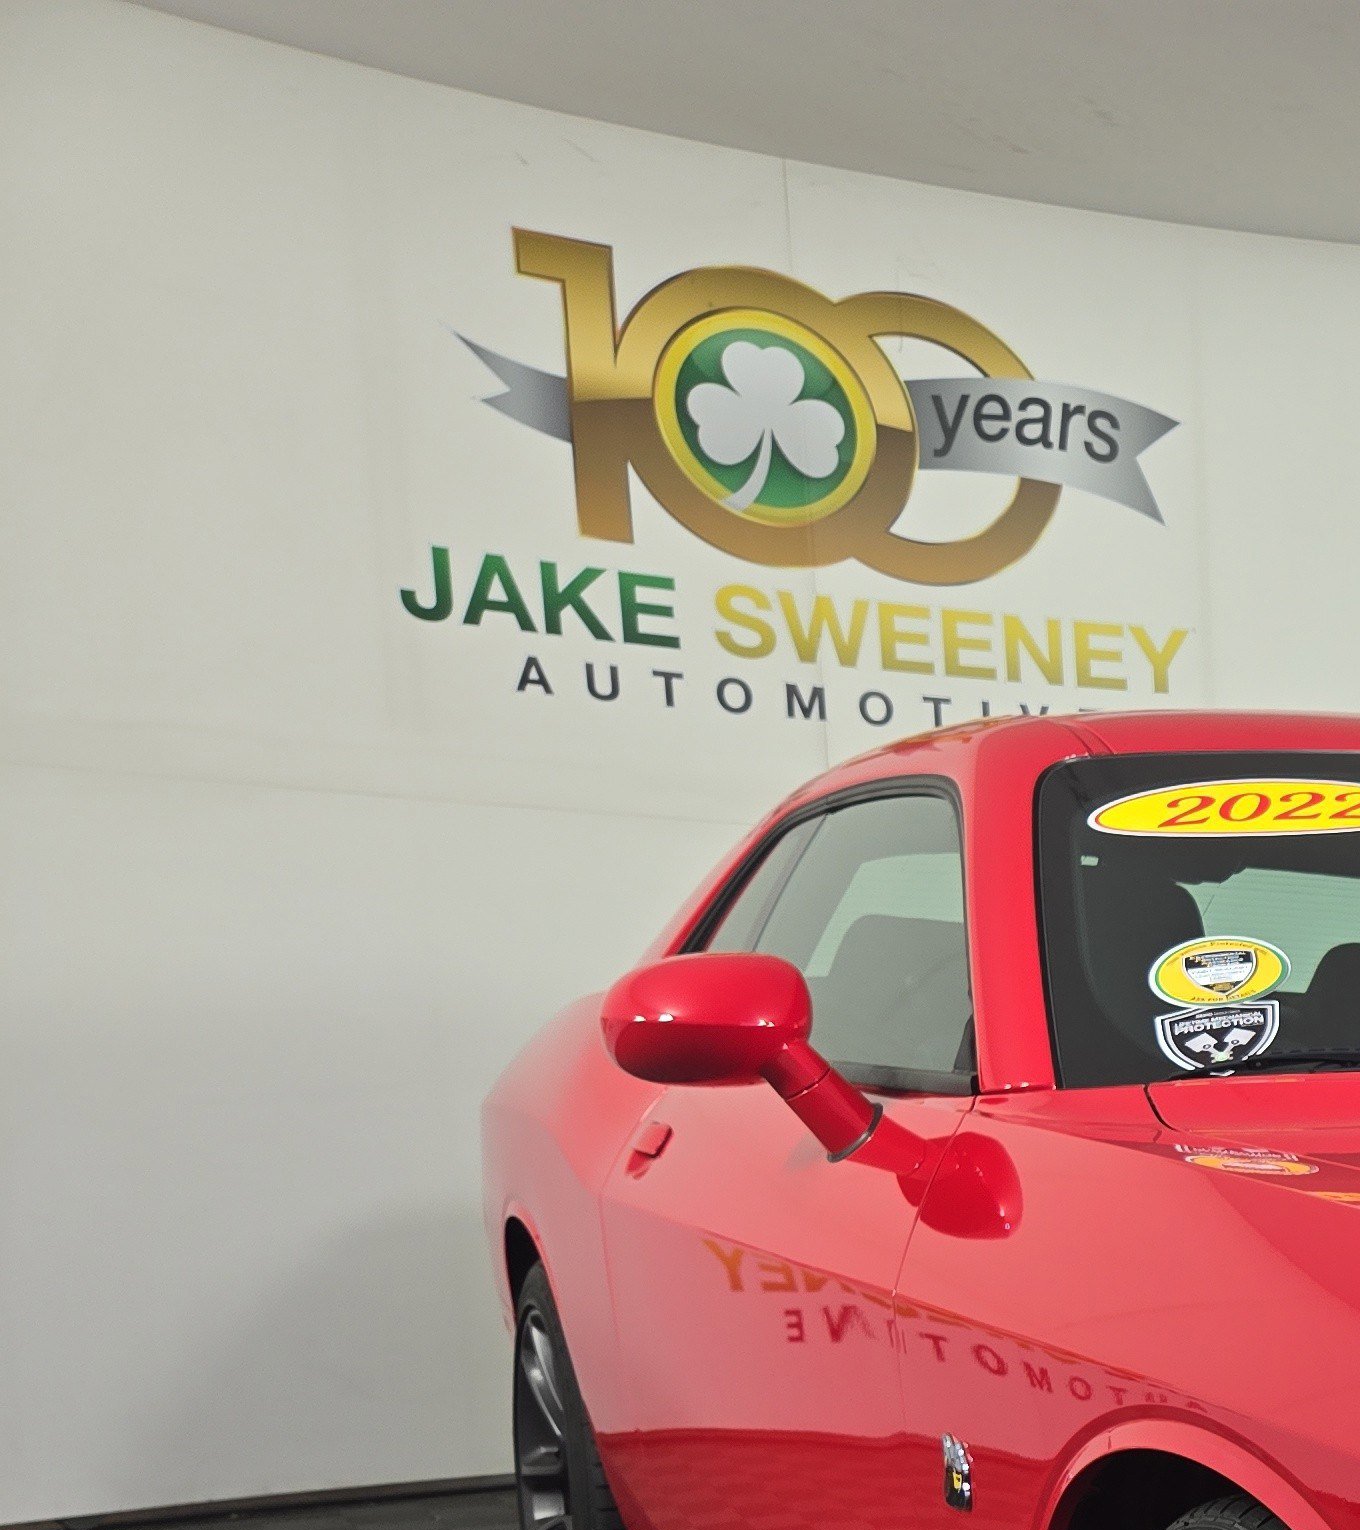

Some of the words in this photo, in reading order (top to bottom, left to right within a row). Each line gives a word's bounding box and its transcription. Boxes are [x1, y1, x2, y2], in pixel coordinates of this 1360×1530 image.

[930, 386, 1122, 464] years
[399, 545, 682, 650] JAKE
[714, 585, 1190, 696] SWEENEY
[516, 657, 1100, 729] AUTOMOT
[1174, 1015, 1265, 1035] PROTECTION
